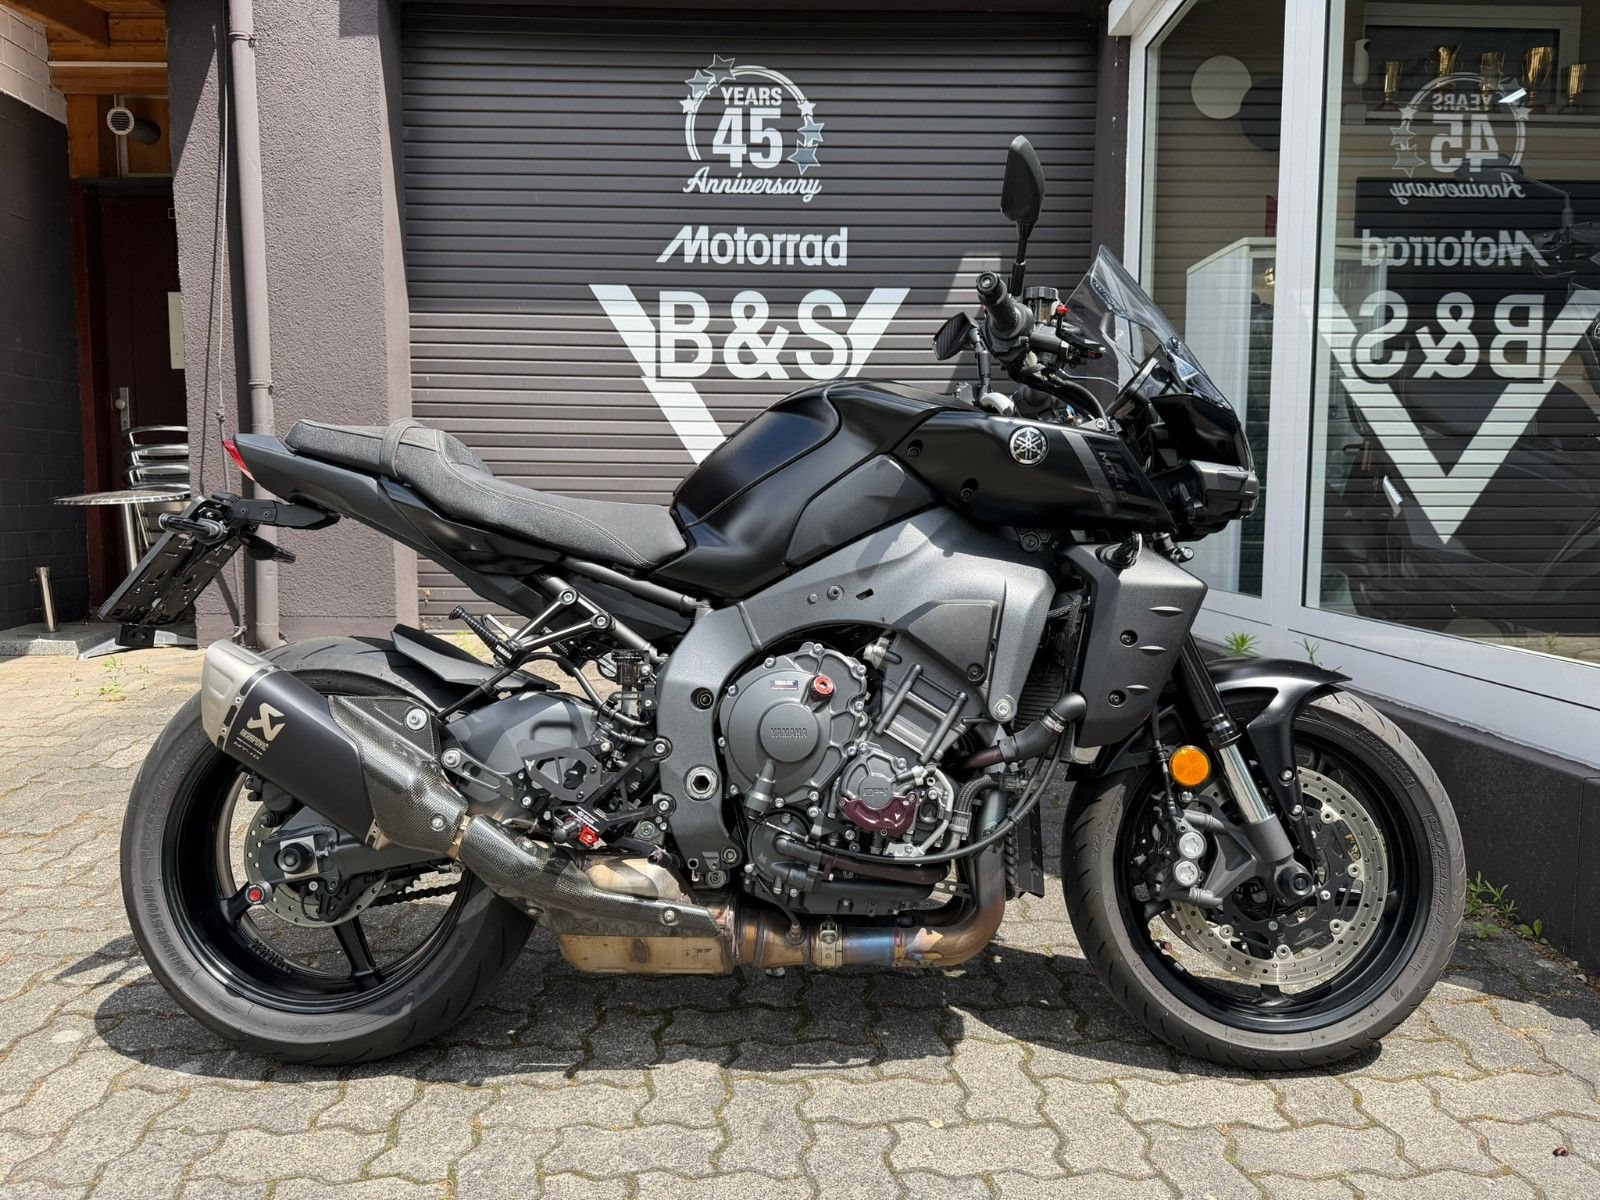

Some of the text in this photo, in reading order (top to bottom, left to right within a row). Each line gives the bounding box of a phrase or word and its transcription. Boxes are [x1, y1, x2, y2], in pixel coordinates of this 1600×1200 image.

[720, 87, 782, 106] YEARS
[712, 107, 783, 169] 45
[683, 166, 822, 202] Anniversary
[656, 226, 848, 266] Motorrad
[659, 289, 849, 380] B&S
